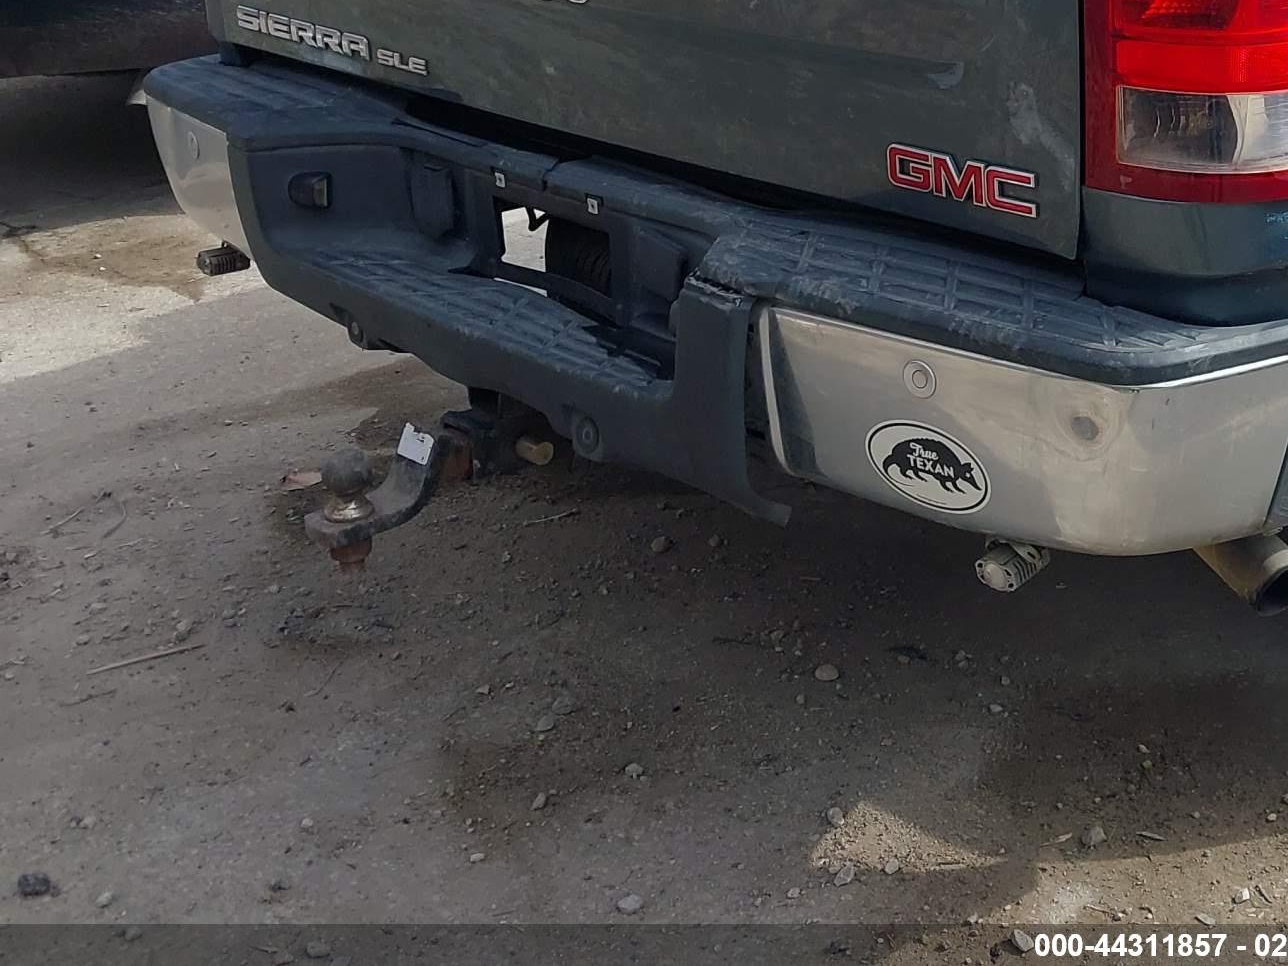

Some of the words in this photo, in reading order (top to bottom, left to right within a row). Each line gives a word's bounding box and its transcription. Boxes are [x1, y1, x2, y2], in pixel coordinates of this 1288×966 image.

[236, 4, 371, 61] SIERRA
[377, 48, 428, 76] SLE
[887, 143, 1037, 218] GMC
[906, 454, 954, 478] TEXAN
[909, 442, 939, 460] True
